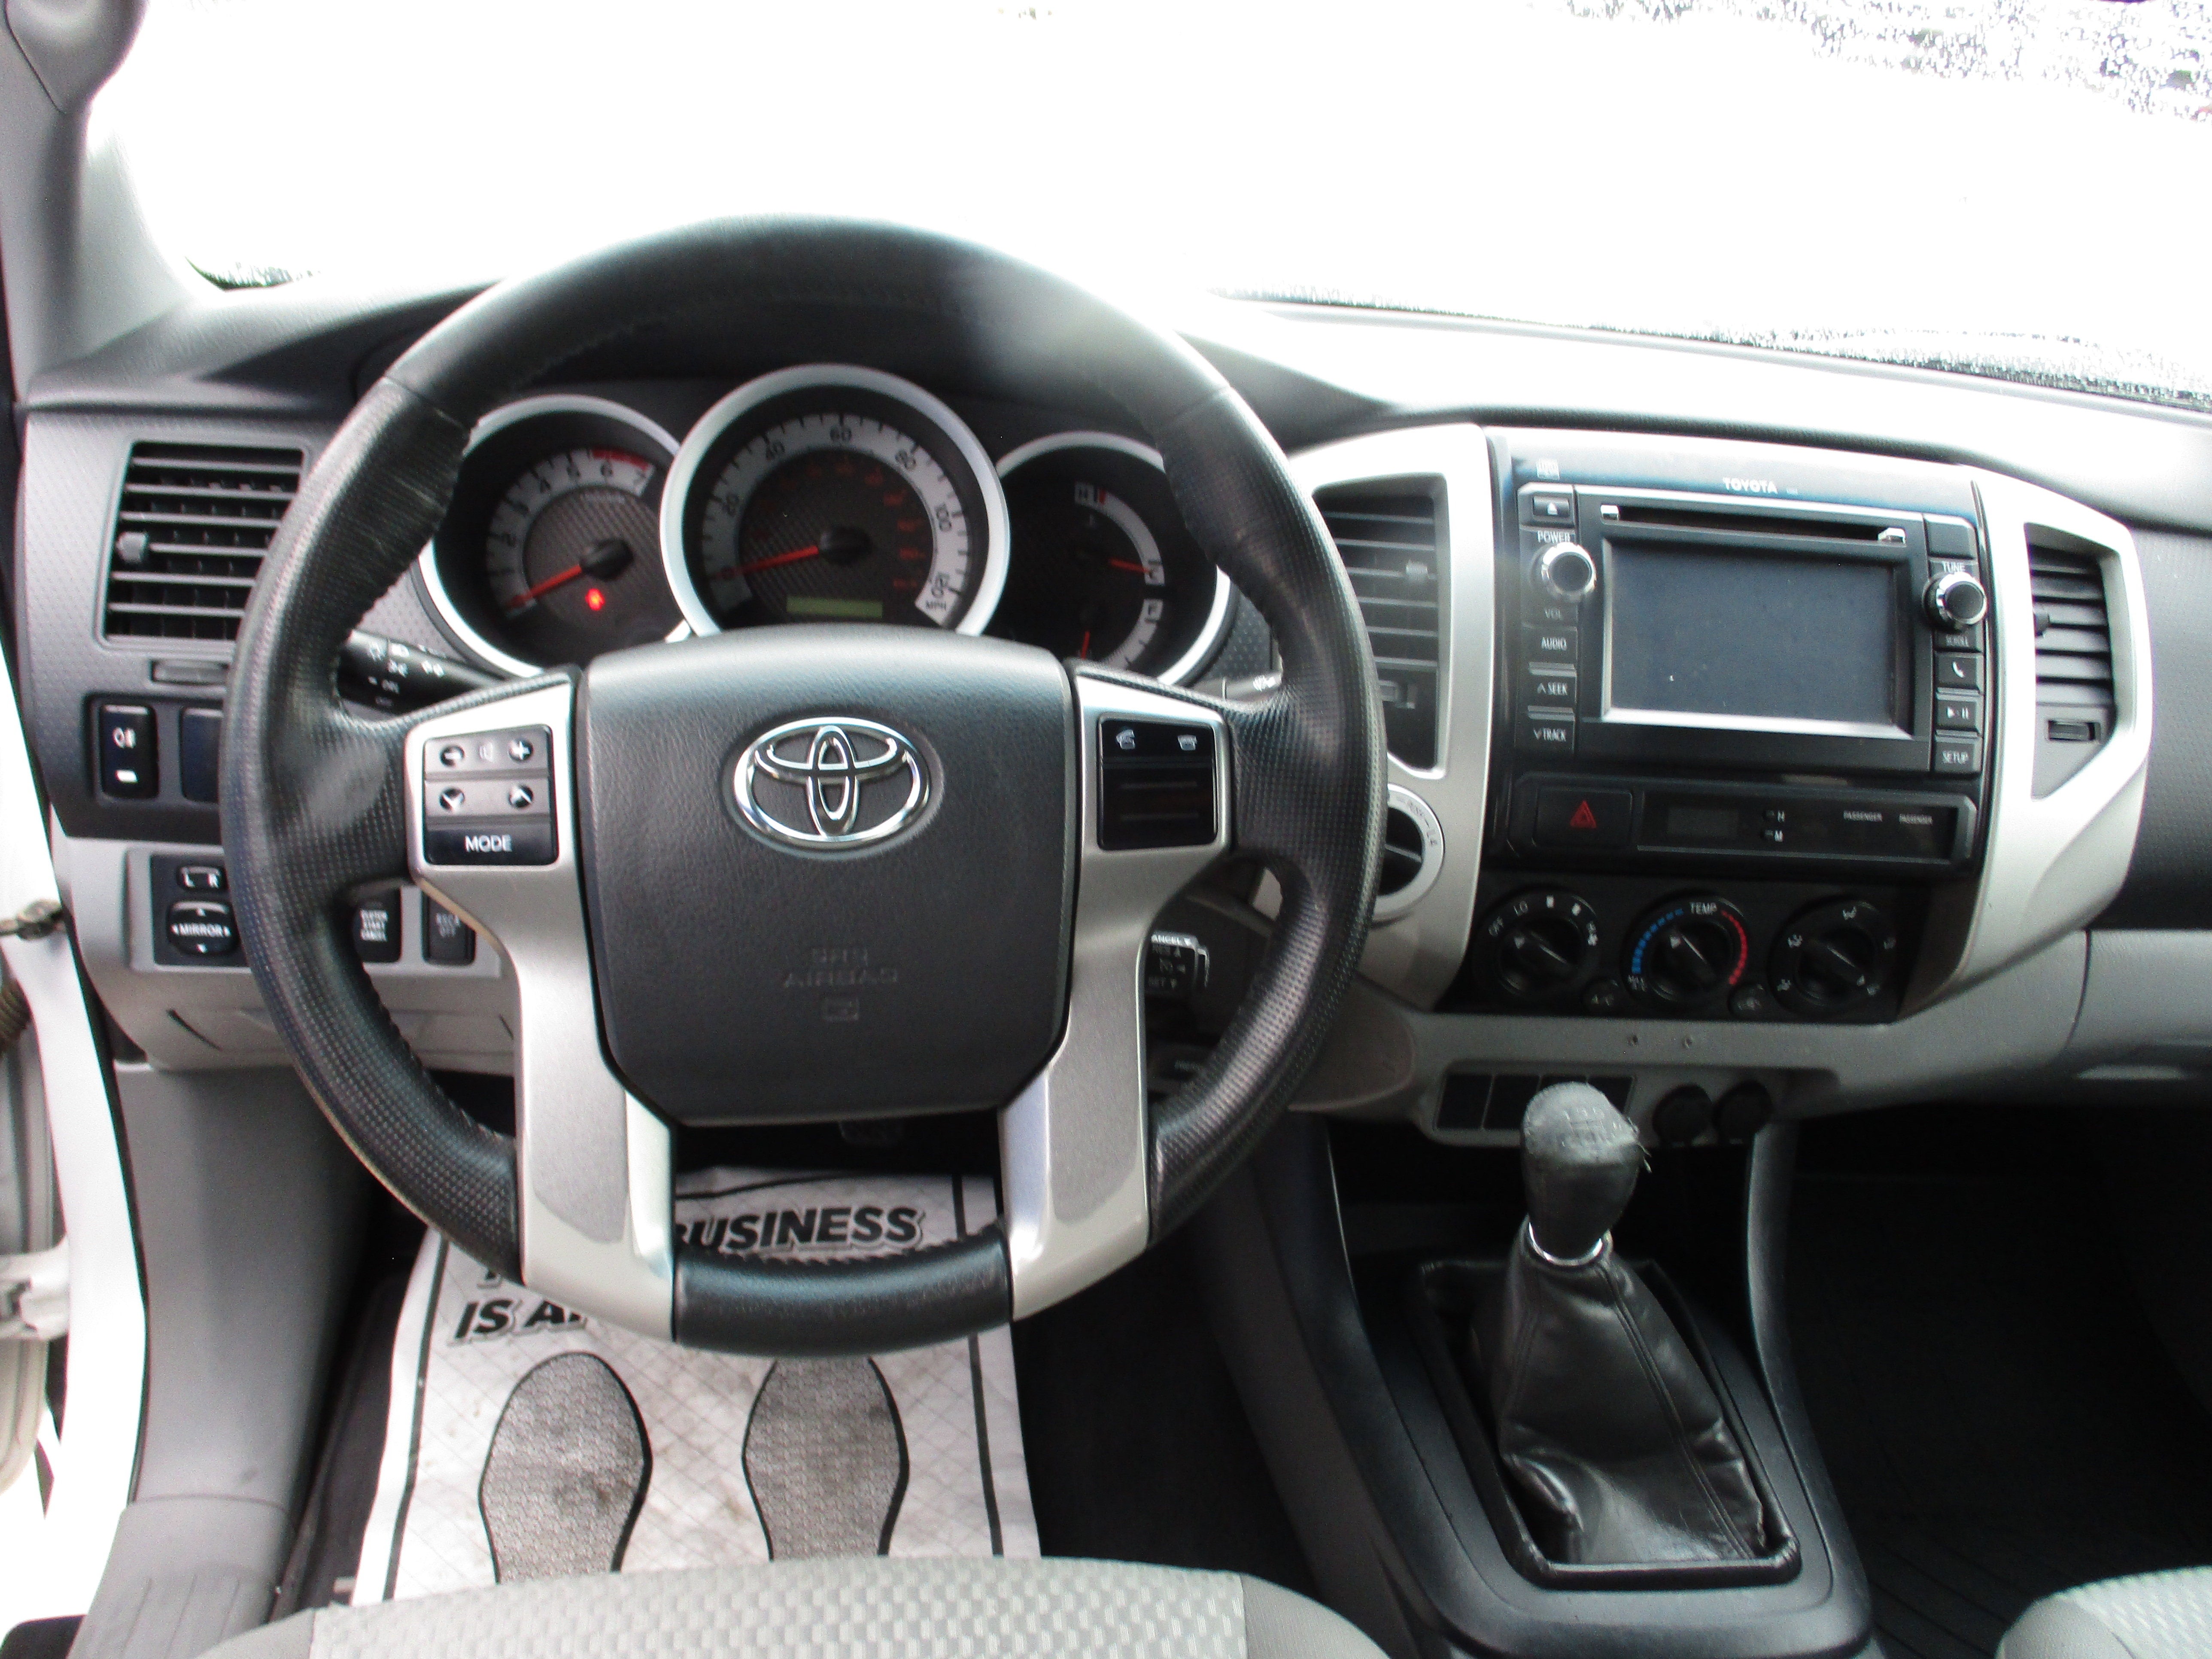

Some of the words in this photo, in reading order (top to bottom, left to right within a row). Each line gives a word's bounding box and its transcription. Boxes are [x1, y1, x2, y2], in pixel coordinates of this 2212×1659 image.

[829, 424, 853, 443] 60
[894, 449, 917, 471] 80
[1723, 477, 1778, 494] TOYOTA
[1537, 530, 1571, 544] POWER
[1942, 561, 1966, 573] TUNE
[1541, 637, 1567, 651] AUDIO
[1547, 683, 1568, 696] SEEK
[1542, 729, 1567, 742] TRACK
[1942, 750, 1969, 765] SETUP
[465, 834, 513, 853] MODE
[1690, 902, 1717, 915] TEMP
[179, 922, 224, 938] MIRROR
[1151, 933, 1183, 946] ANCEL
[454, 1298, 513, 1339] IS
[523, 1300, 581, 1327] A
